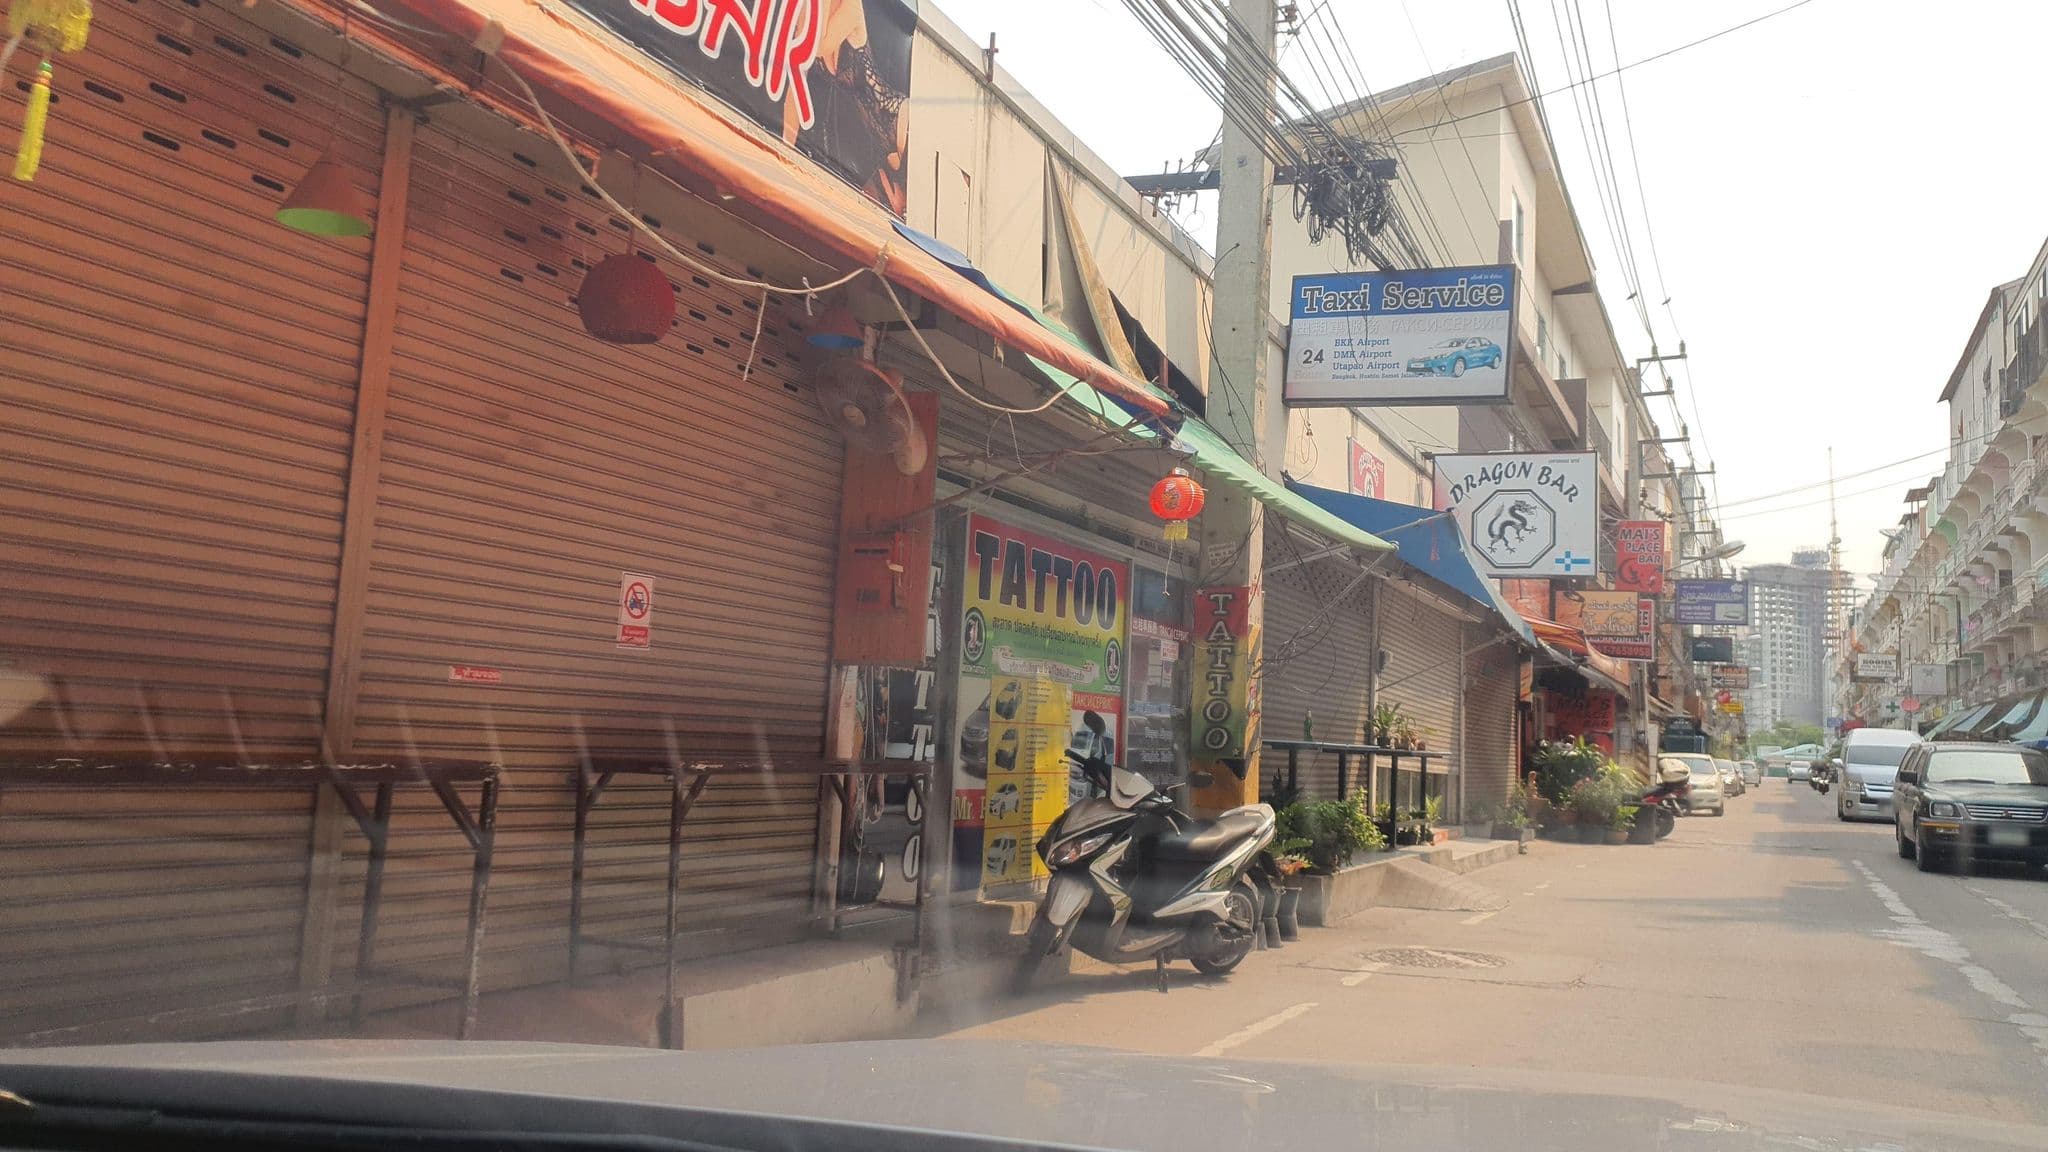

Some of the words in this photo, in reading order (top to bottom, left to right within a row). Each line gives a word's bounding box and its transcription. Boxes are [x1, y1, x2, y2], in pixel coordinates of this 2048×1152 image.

[1302, 283, 1370, 314] Taxi
[1382, 278, 1505, 310] Service
[1334, 339, 1354, 347] BKK
[1357, 338, 1389, 347] Airport
[1302, 349, 1325, 365] 24
[1359, 350, 1392, 359] Airport
[1333, 362, 1363, 372] Utapao
[1366, 361, 1399, 371] Airport
[1449, 461, 1533, 504] DRAGON
[1537, 466, 1579, 502] BAR
[1619, 527, 1660, 540] MAI'S
[1625, 542, 1660, 553] PLACE
[1638, 554, 1661, 565] BAR
[975, 529, 1117, 631] TATTOO
[1204, 592, 1234, 750] TATTOO
[954, 796, 975, 821] Mr.
